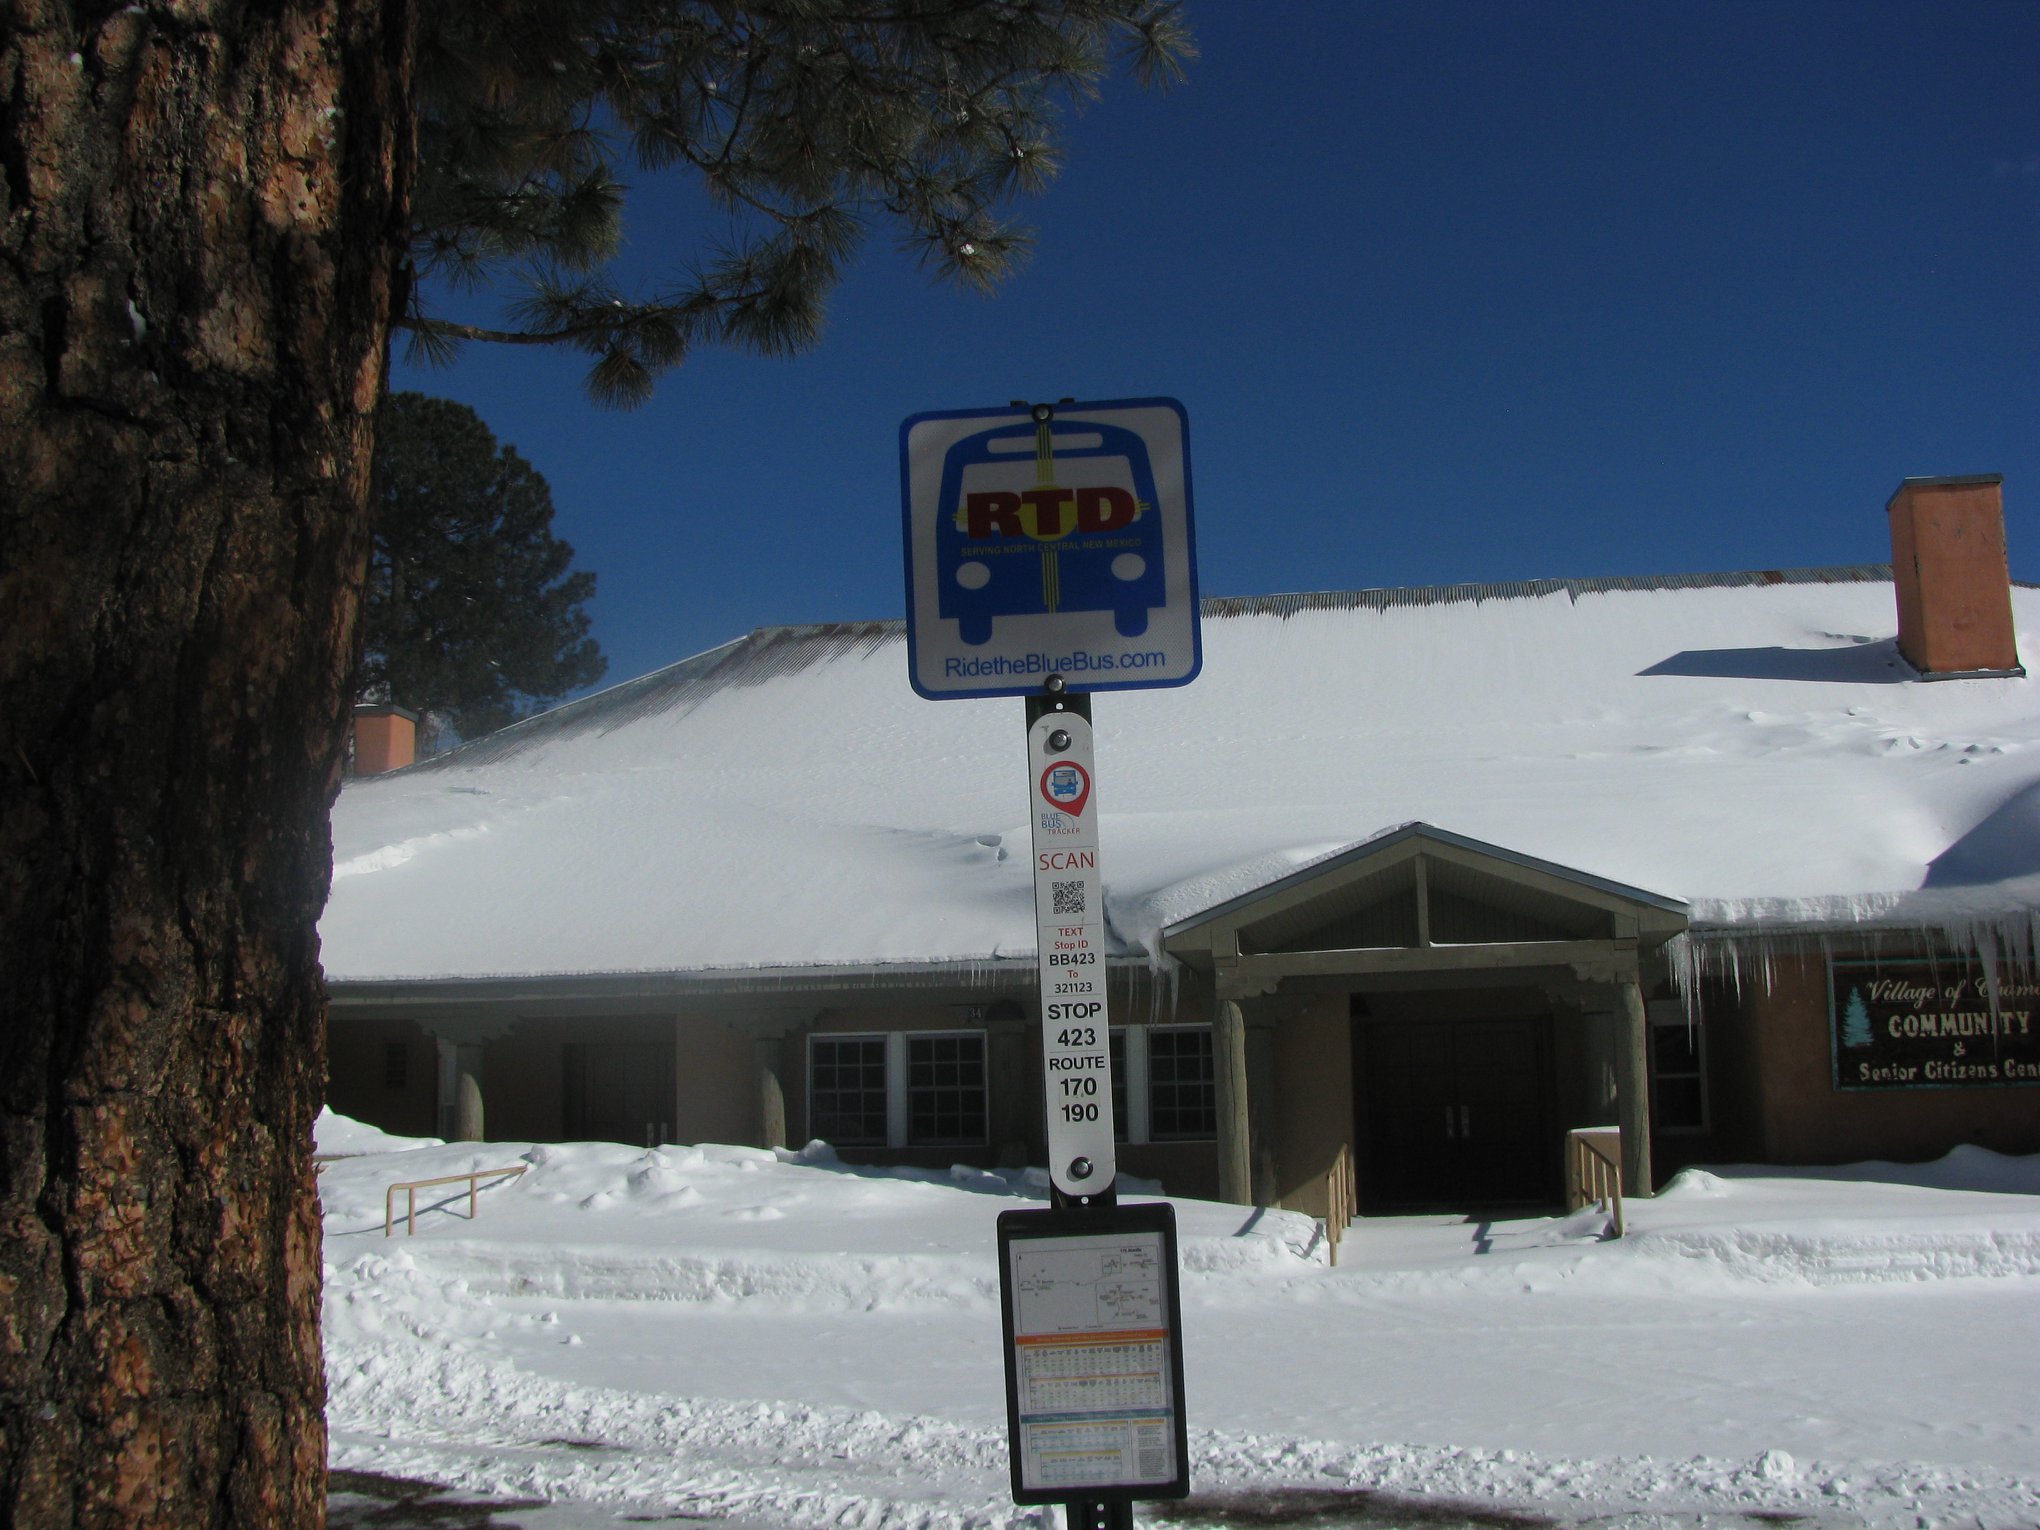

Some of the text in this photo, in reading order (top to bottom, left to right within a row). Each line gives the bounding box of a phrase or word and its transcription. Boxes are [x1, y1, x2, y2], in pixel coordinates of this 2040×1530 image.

[967, 487, 1135, 539] RTD
[961, 537, 1142, 557] SERVING NORTH CENTRAL NEW MEXICO
[945, 651, 1165, 677] RidetheBlueBus.com
[1042, 819, 1061, 829] BUS
[1039, 852, 1095, 870] SCAN
[1058, 928, 1083, 936] TEXT
[1054, 940, 1089, 950] Stop ID
[1049, 953, 1095, 966] BB423
[1067, 970, 1079, 978] To
[1054, 982, 1093, 993] 321123
[1866, 979, 1936, 1009] Village
[1945, 979, 1967, 1008] of
[1048, 1003, 1101, 1020] STOP
[1058, 1028, 1096, 1046] 423
[1953, 1041, 1966, 1056] &
[1050, 1056, 1105, 1070] ROUTE
[1859, 1062, 1917, 1081] Senior
[1924, 1060, 1998, 1080] Citizens
[1060, 1077, 1097, 1096] 170
[1062, 1103, 1098, 1122] 190
